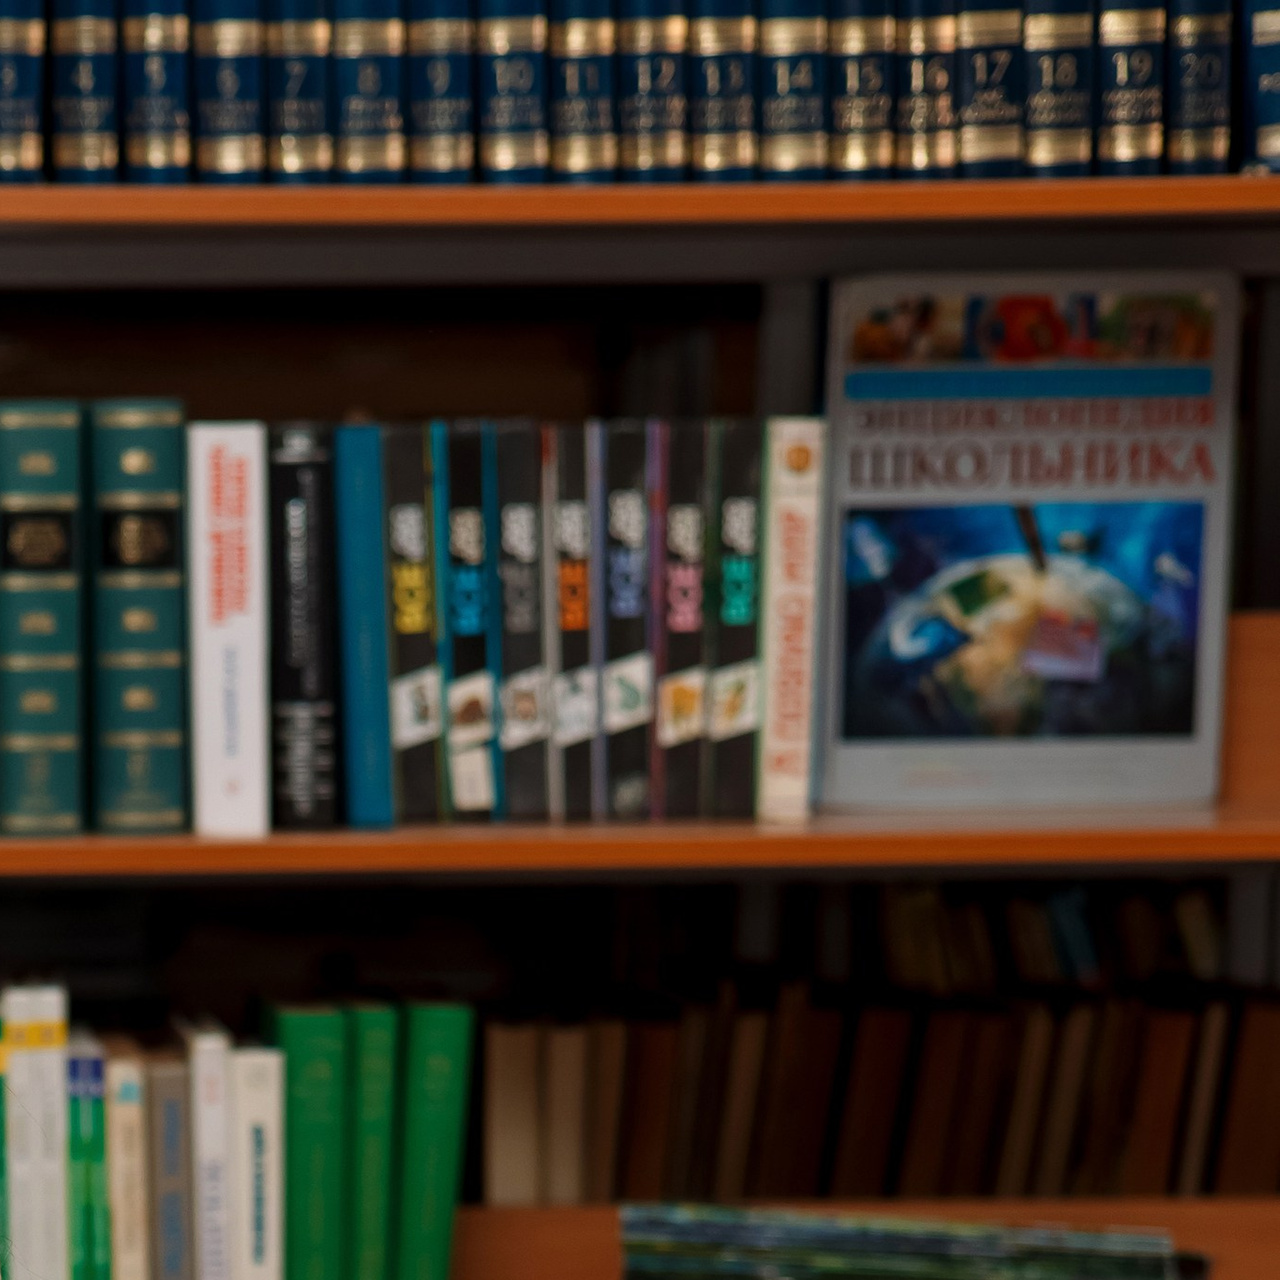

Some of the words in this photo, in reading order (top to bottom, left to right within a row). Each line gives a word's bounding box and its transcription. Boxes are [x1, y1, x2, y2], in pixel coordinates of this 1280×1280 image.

[71, 58, 95, 94] 4
[285, 58, 309, 97] 7
[426, 57, 451, 95] 9
[494, 56, 535, 95] 10
[561, 58, 599, 93] 11
[635, 56, 676, 95] 12
[702, 57, 744, 96] 13
[773, 57, 814, 96] 14
[844, 56, 884, 95] 15
[910, 56, 950, 93] 16
[972, 50, 1012, 86] 17
[1039, 53, 1078, 88] 18
[1112, 51, 1153, 86] 19
[1179, 51, 1223, 89] 20
[848, 434, 1218, 488] ШКОЛЬНИКА
